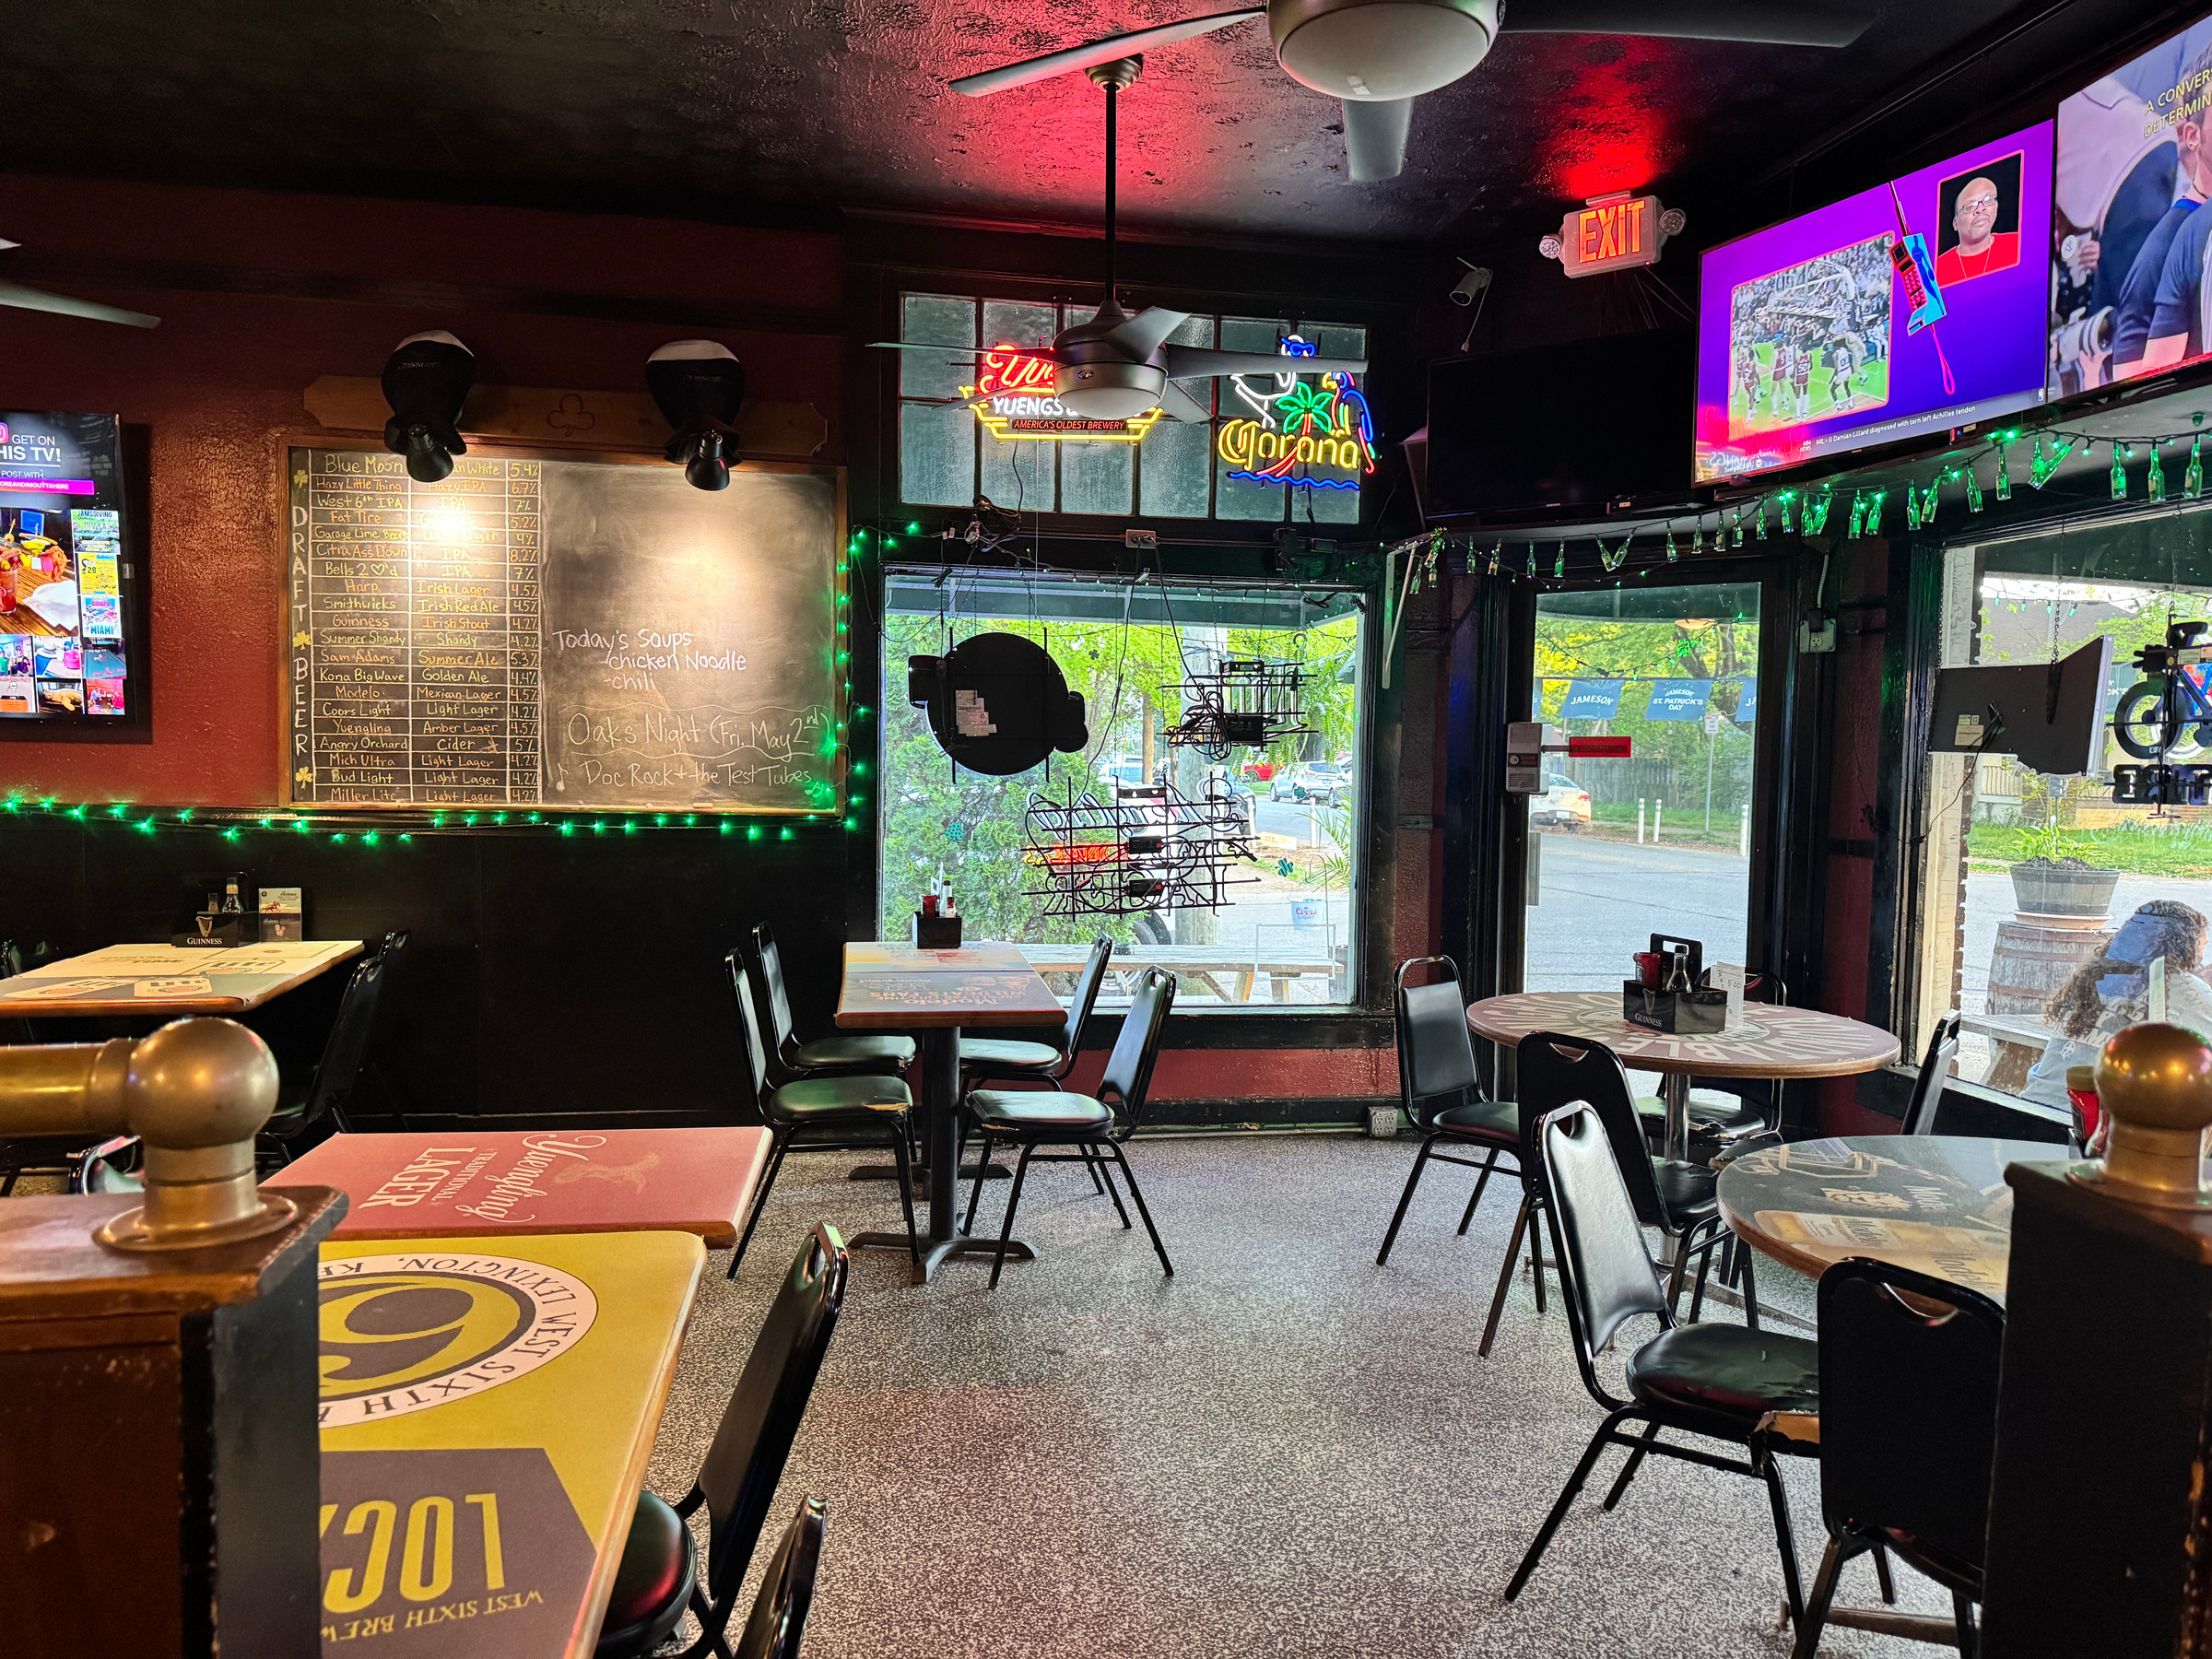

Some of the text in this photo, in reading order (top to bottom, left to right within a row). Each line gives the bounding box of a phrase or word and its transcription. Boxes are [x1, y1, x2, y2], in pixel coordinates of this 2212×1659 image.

[2146, 68, 2212, 115] A CONVER
[1579, 200, 1645, 264] EXIT
[1014, 420, 1124, 430] AMERICA'S OLDEST BREWERY
[1833, 432, 1853, 442] Damian
[1853, 428, 1869, 438] Lillard
[1869, 422, 1897, 434] diagnosed
[1897, 419, 1909, 428] with
[1910, 417, 1922, 425] torn
[1922, 415, 1932, 423] left
[1932, 410, 1955, 420] Achilles
[1955, 406, 1976, 415] tendon
[12, 434, 55, 446] GET ON
[1218, 418, 1359, 471] Corona
[30, 446, 62, 462] TV!
[325, 454, 403, 474] Blue Moon
[467, 460, 500, 476] White
[510, 463, 539, 477] 5.4%
[1, 470, 44, 479] POST WITH
[316, 477, 403, 493] Hazy Little Thing
[428, 480, 487, 496] Hazy IPA
[512, 481, 537, 495] 6.7%
[317, 493, 352, 507] West
[376, 498, 403, 509] IPA
[331, 510, 382, 524] Fat Tire
[511, 515, 537, 529] 5.2%
[314, 525, 381, 541] Garage Lime
[316, 543, 407, 559] Citra Ass Down
[440, 547, 472, 561] IPA
[509, 548, 539, 563] 8.2%
[88, 566, 97, 574] 28
[325, 561, 354, 576] Bells
[441, 564, 472, 578] IPA
[345, 580, 378, 594] Harp
[417, 581, 489, 598] Irish Lager
[324, 597, 395, 610] Smithwicks
[418, 599, 500, 613] Irish Red Ale
[333, 612, 390, 628] Guinness
[421, 616, 490, 629] Irish Stout
[90, 625, 114, 636] MIAMI
[291, 507, 309, 756] DRAFT BEER
[320, 630, 406, 646] Summer Shandy
[437, 632, 478, 646] Shandy
[552, 629, 629, 664] Today's
[321, 649, 395, 664] Sam Adams
[418, 650, 500, 665] Summer Ale
[686, 649, 747, 672] Noodle
[320, 667, 405, 684] Kona Big Wave
[422, 668, 489, 684] Golden Ale
[510, 671, 537, 685] 4.4%
[335, 685, 381, 699] Modelo
[417, 688, 501, 702] Mexican Lager
[1665, 688, 1695, 699] JAMESON
[323, 701, 392, 716] Coors Light
[427, 700, 498, 717] Light Lager
[1571, 695, 1614, 706] JAMESON
[1664, 698, 1704, 706] PATRICK'S
[333, 719, 392, 735] Yuengling
[423, 720, 499, 736] Amber Lager
[320, 735, 408, 751] Angry Orchard
[436, 737, 475, 751] Cider
[568, 712, 637, 748] Oaks
[645, 712, 700, 753] Night
[751, 720, 793, 762] May
[329, 752, 395, 767] Mich Ultra
[421, 754, 494, 770] Light Lager
[331, 768, 394, 783] Bud Light
[424, 770, 500, 785] Light Lager
[512, 771, 537, 785] 4.2%
[580, 759, 812, 786] Doc Rock the Test Tubes
[331, 787, 396, 802] Miller Lite
[426, 788, 496, 804] Light Lager
[1296, 906, 1317, 915] Coors
[187, 937, 222, 946] GUINNESS
[1634, 1012, 1663, 1028] GUINNESS
[358, 1147, 477, 1210] LAGER
[431, 1148, 499, 1206] TRADITIONAL
[455, 1133, 607, 1224] Yuengling
[363, 1317, 575, 1416] WEST SIXTH
[320, 1492, 505, 1614] LOC
[485, 1587, 544, 1614] WEST
[406, 1598, 478, 1630] SIXTH
